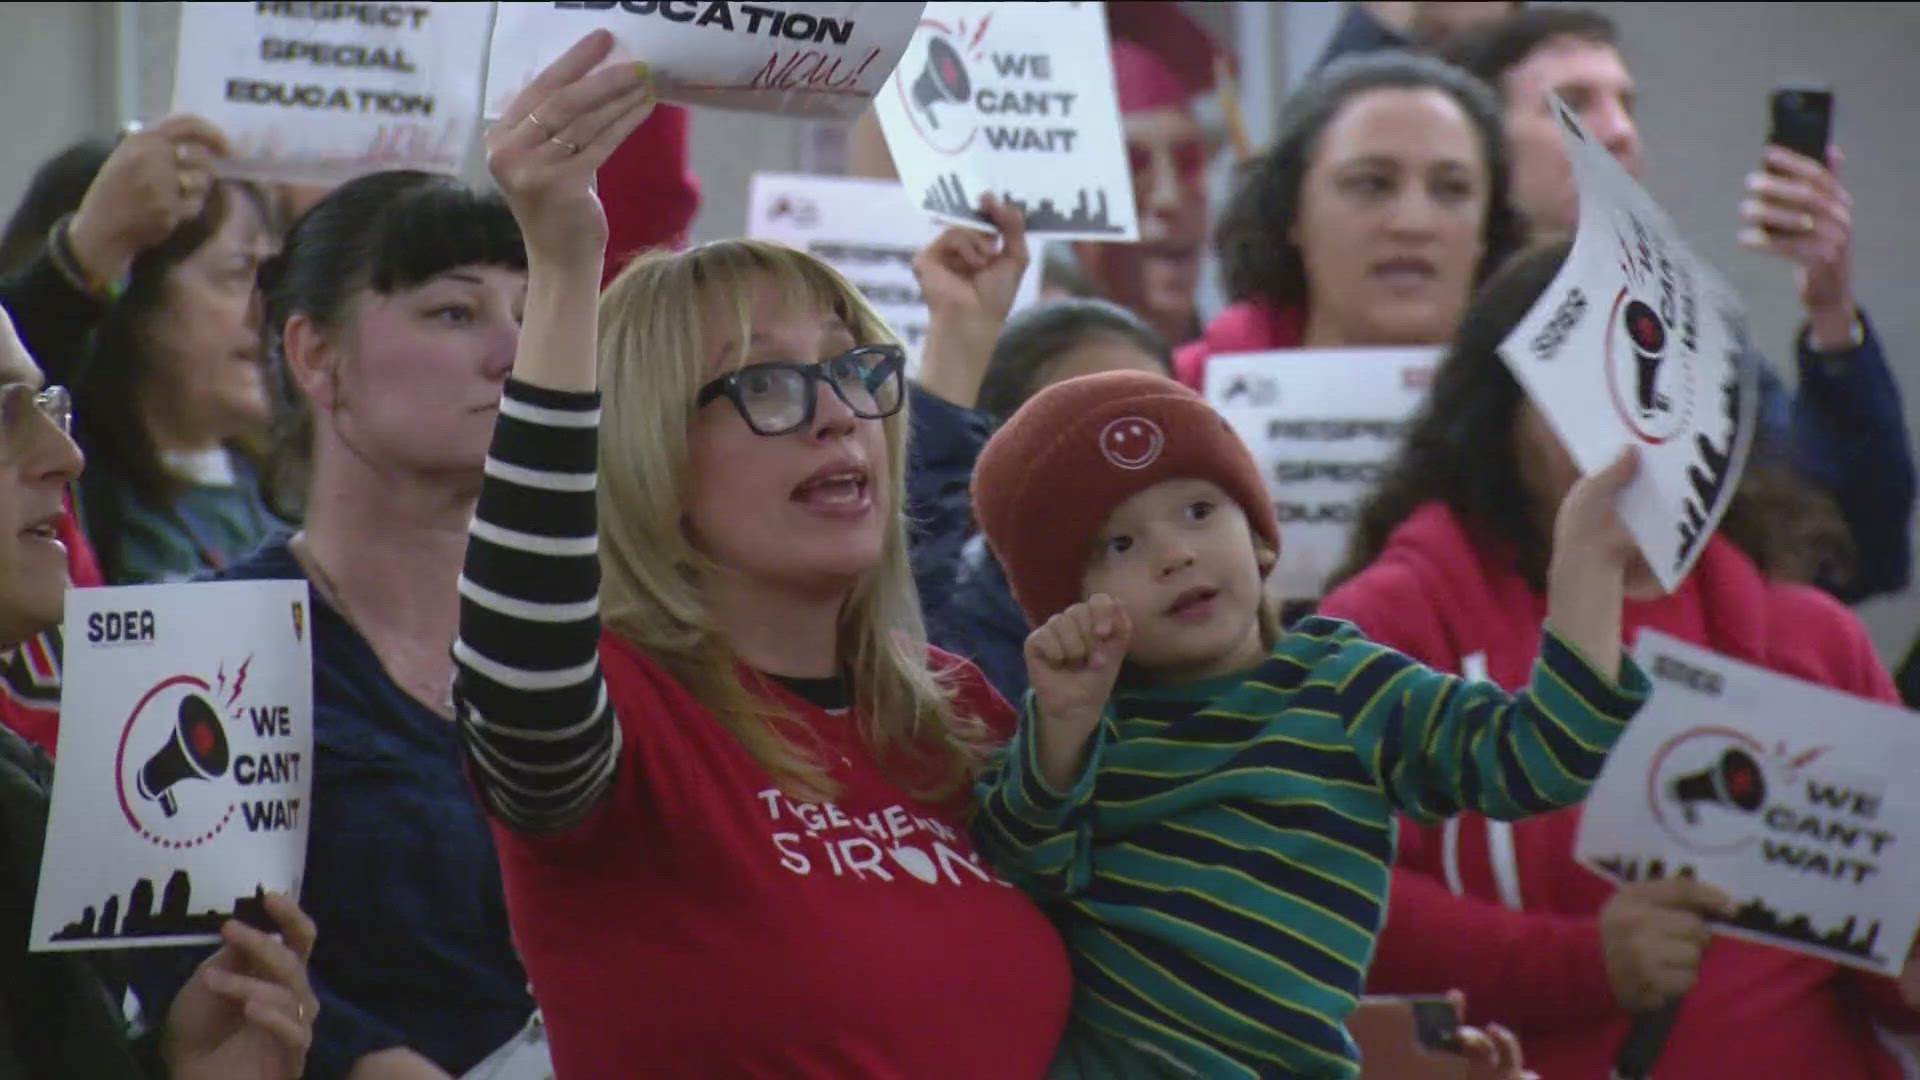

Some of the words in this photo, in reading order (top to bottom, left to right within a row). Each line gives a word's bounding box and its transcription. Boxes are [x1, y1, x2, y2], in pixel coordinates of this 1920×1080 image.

[256, 2, 430, 29] RESPECT
[261, 39, 416, 73] SPECIAL
[752, 48, 880, 91] NOW!
[991, 52, 1050, 79] WE
[225, 79, 435, 116] EDUCATION
[984, 126, 1078, 152] WAIT
[87, 610, 155, 642] SDEA
[249, 706, 291, 737] WE
[241, 798, 301, 833] WAIT
[1806, 778, 1882, 819] WE
[1762, 837, 1880, 885] WAIT
